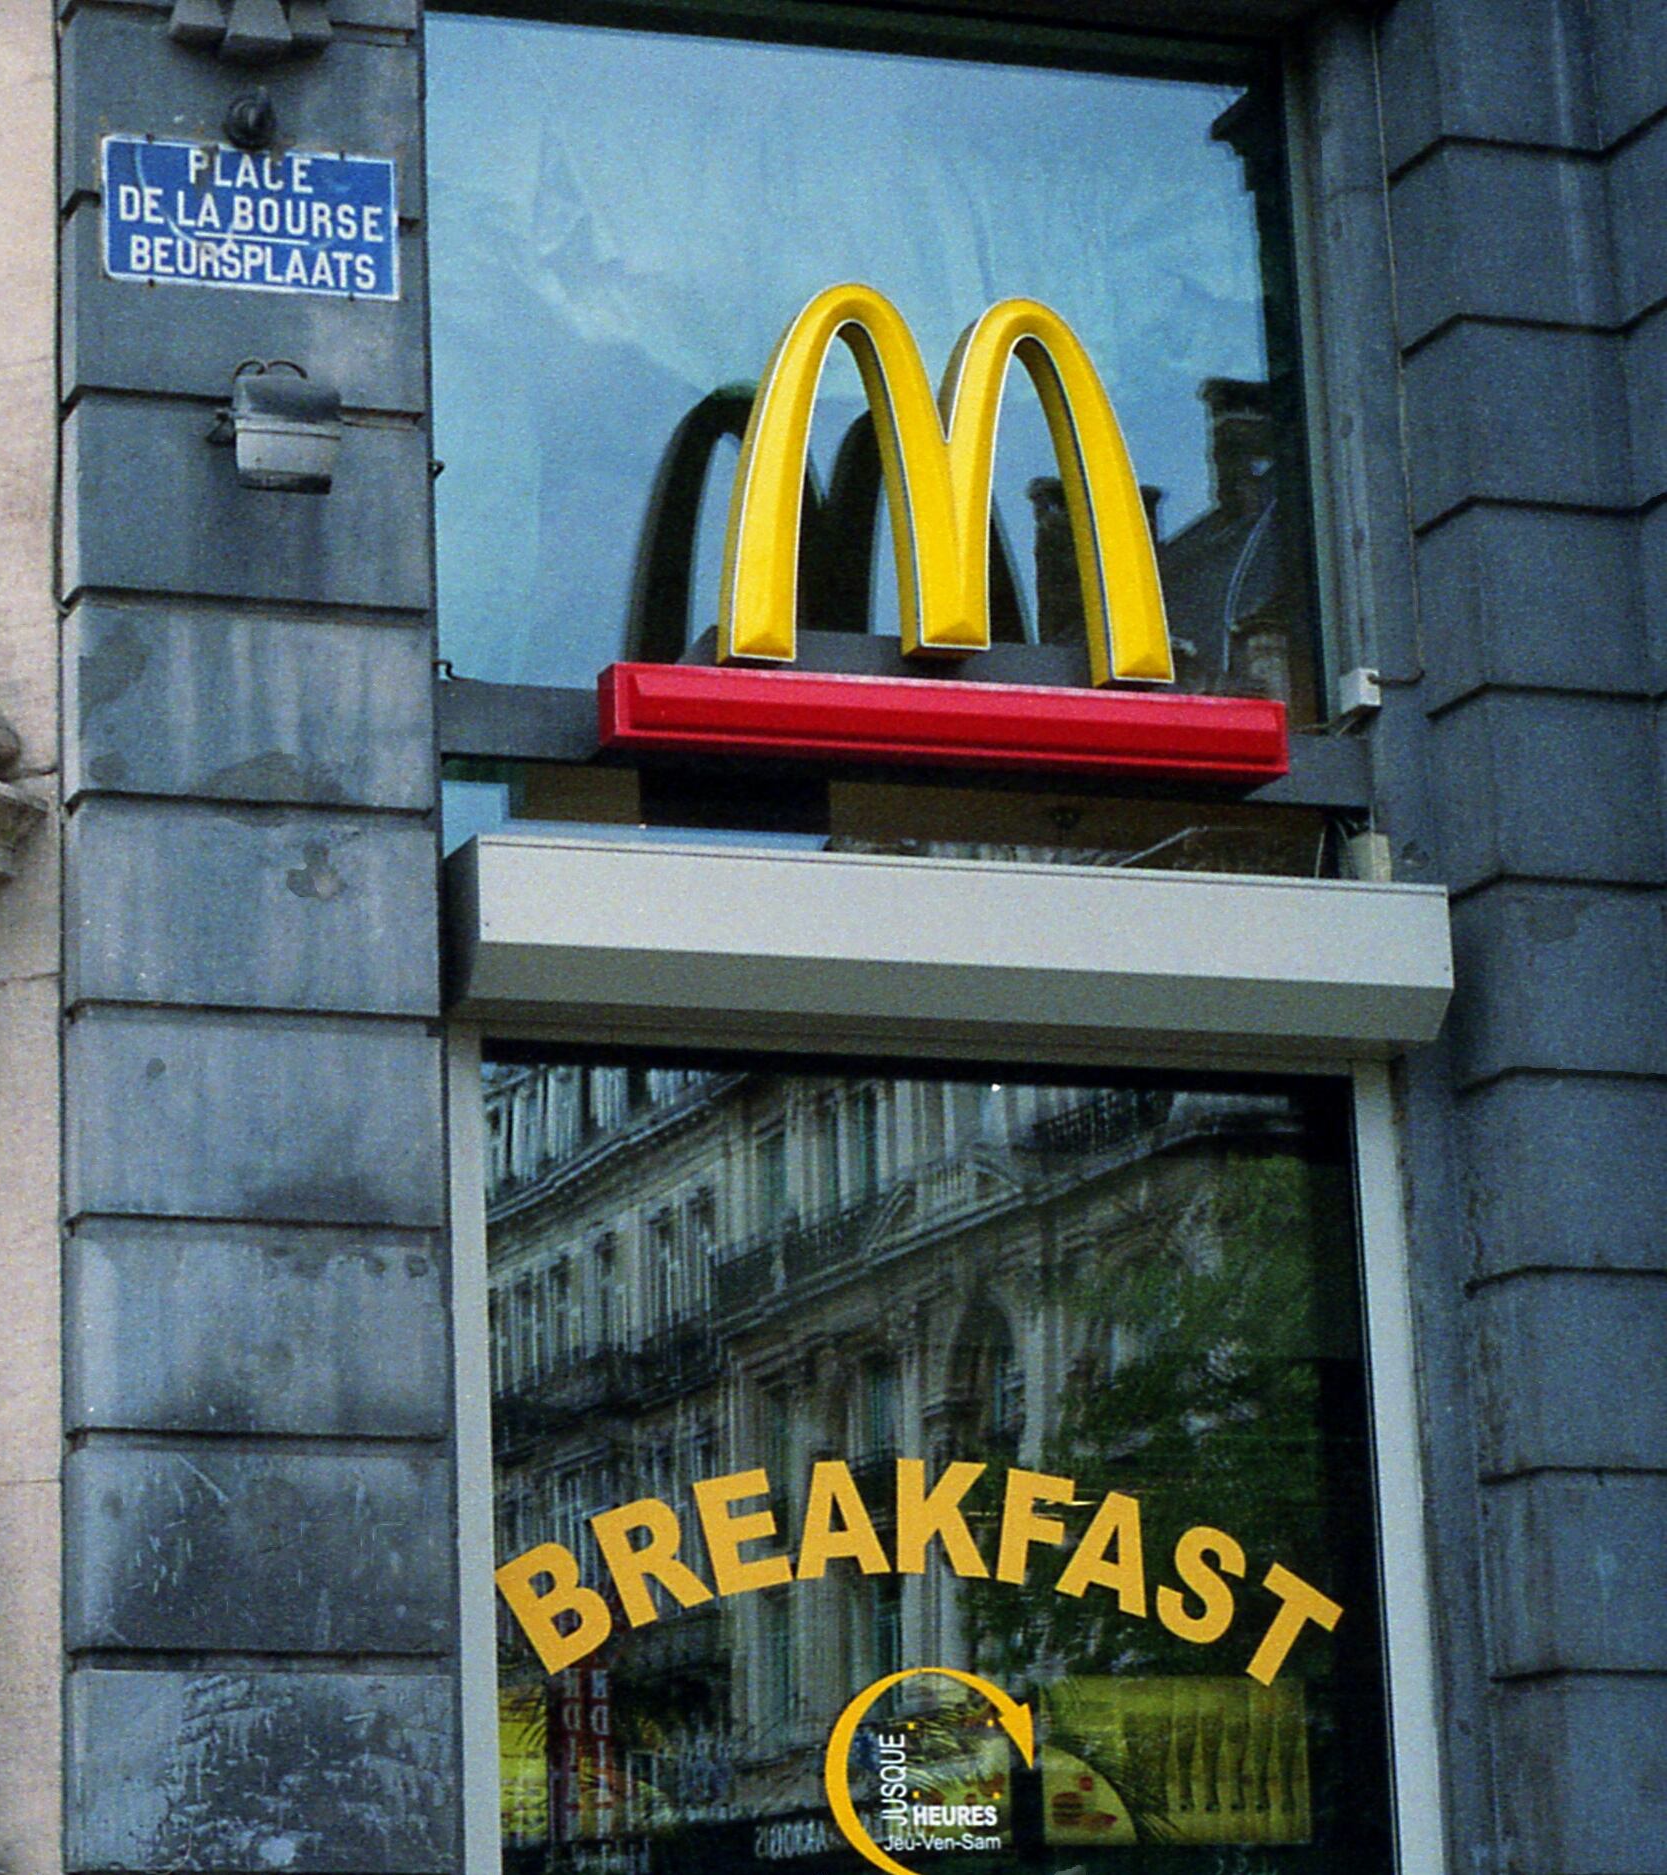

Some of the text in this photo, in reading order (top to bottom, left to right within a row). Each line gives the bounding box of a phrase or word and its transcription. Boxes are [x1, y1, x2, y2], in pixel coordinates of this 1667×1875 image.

[189, 149, 313, 193] PLACE
[118, 184, 384, 242] DE LA BOURSE
[130, 234, 377, 290] BEURSPLAATS
[493, 1456, 1345, 1687] BREAKFAST
[878, 1733, 909, 1826] JUSQUE
[883, 1832, 1002, 1852] Jeu-Ven-Sam
[912, 1803, 999, 1827] HEURES
